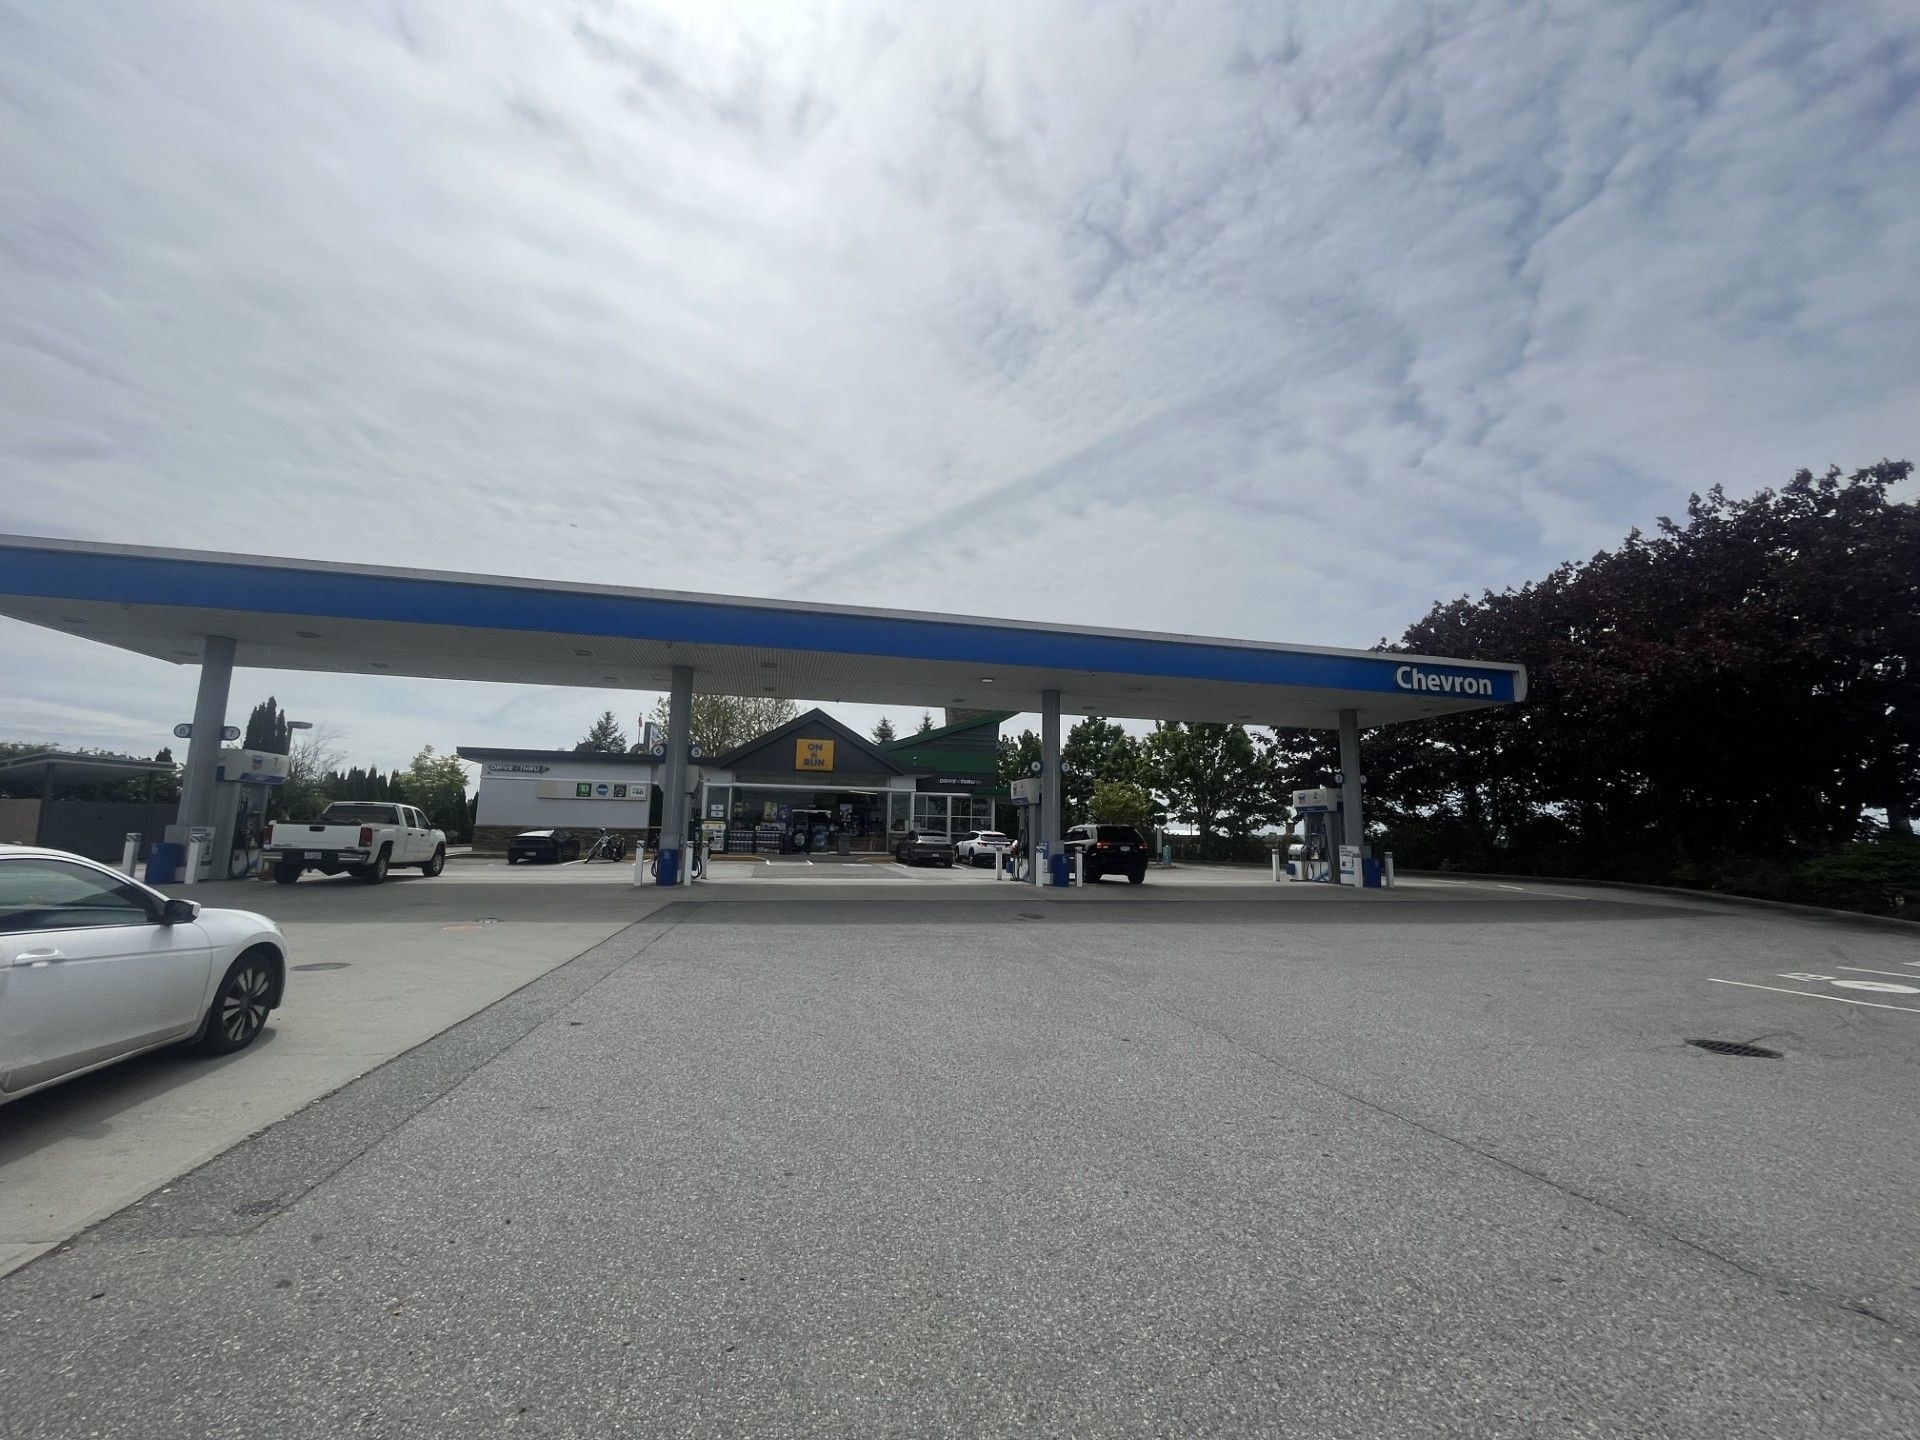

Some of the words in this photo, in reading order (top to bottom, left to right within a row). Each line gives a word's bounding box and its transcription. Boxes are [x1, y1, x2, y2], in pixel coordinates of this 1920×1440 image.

[1396, 665, 1492, 695] Chevron
[807, 743, 823, 751] ON
[803, 758, 825, 767] RUN
